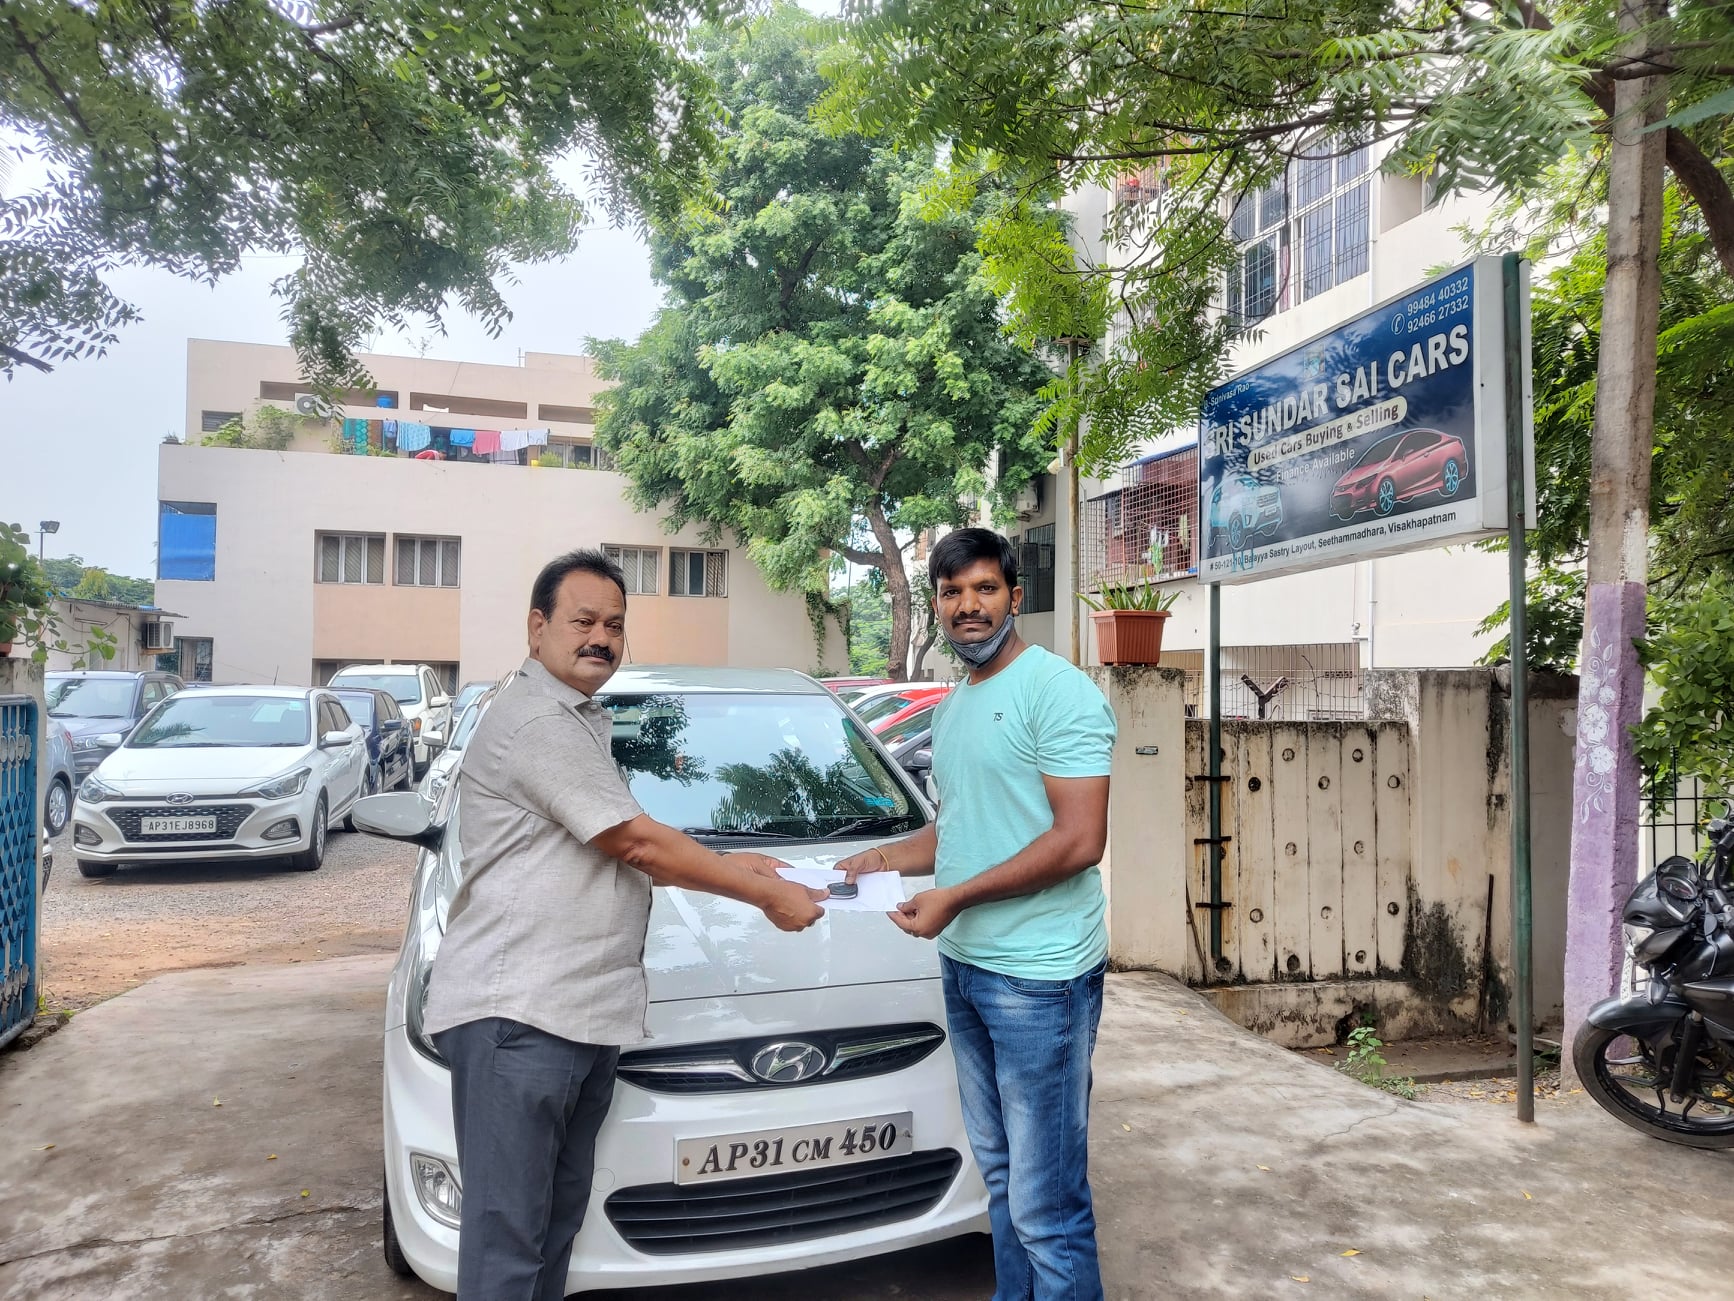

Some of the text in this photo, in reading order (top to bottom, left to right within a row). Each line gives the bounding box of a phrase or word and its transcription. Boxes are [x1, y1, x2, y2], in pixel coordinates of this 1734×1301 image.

[1407, 277, 1469, 316] 99484 40332
[1407, 295, 1469, 333] 92466 27332
[1238, 382, 1250, 394] Rao
[1240, 383, 1329, 446] SUNDAR
[1336, 361, 1378, 409] SAI
[1388, 324, 1470, 389] CARS
[1254, 404, 1399, 465] Used Cars Buying & Selling
[1276, 447, 1356, 482] Finance Available
[1269, 546, 1290, 559] Sastry
[1291, 538, 1317, 555] Layout,
[1318, 526, 1387, 548] Seethammadhara,
[1388, 511, 1457, 533] Visakhapatnam
[148, 819, 215, 831] AP31EJ8968
[696, 1120, 897, 1175] AP31 CM 450
